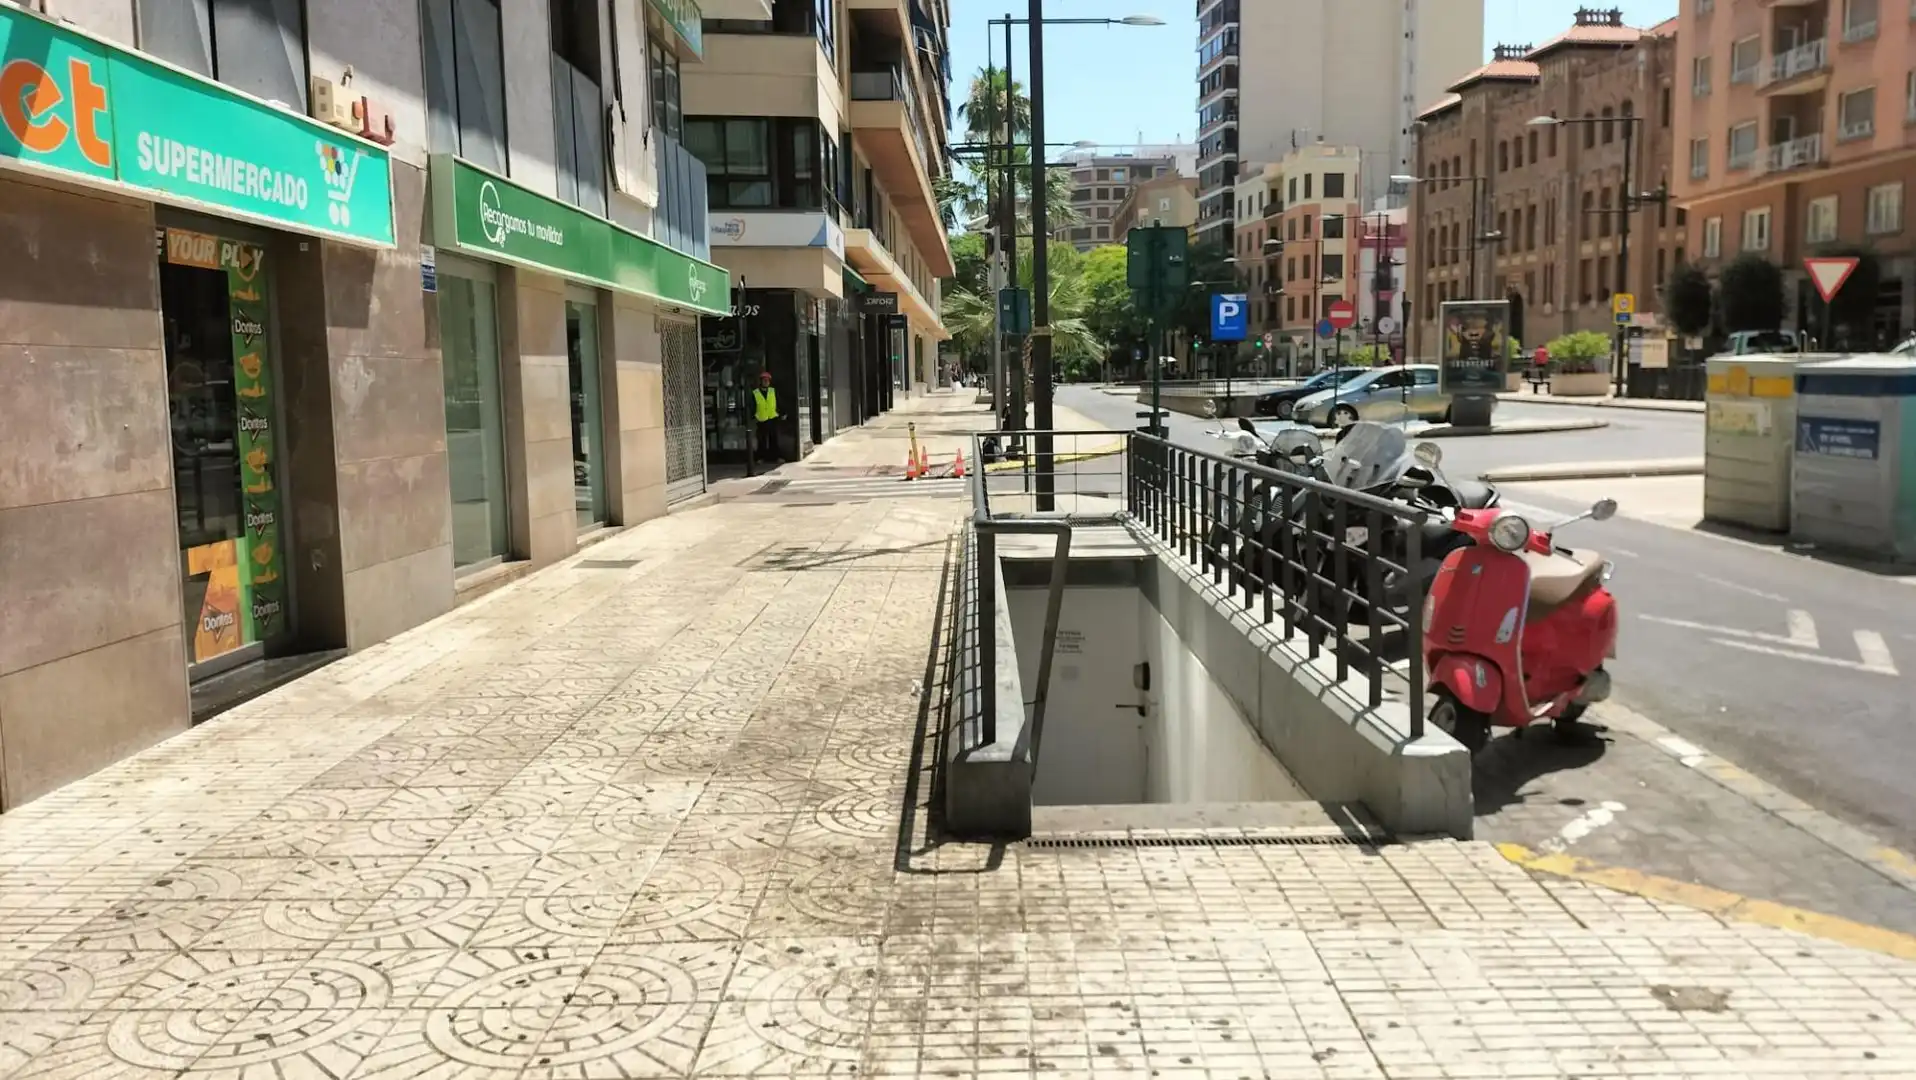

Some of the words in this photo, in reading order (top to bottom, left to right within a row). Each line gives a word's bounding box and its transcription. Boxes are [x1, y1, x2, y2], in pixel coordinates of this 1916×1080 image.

[137, 131, 308, 211] SUPERMERCADO
[168, 232, 216, 265] YOUR
[1219, 301, 1240, 326] P
[234, 319, 263, 335] Doritos
[241, 416, 268, 431] Doritos
[248, 512, 274, 527] Doritos
[253, 601, 279, 619] Doritos
[204, 613, 233, 632] Doritos
